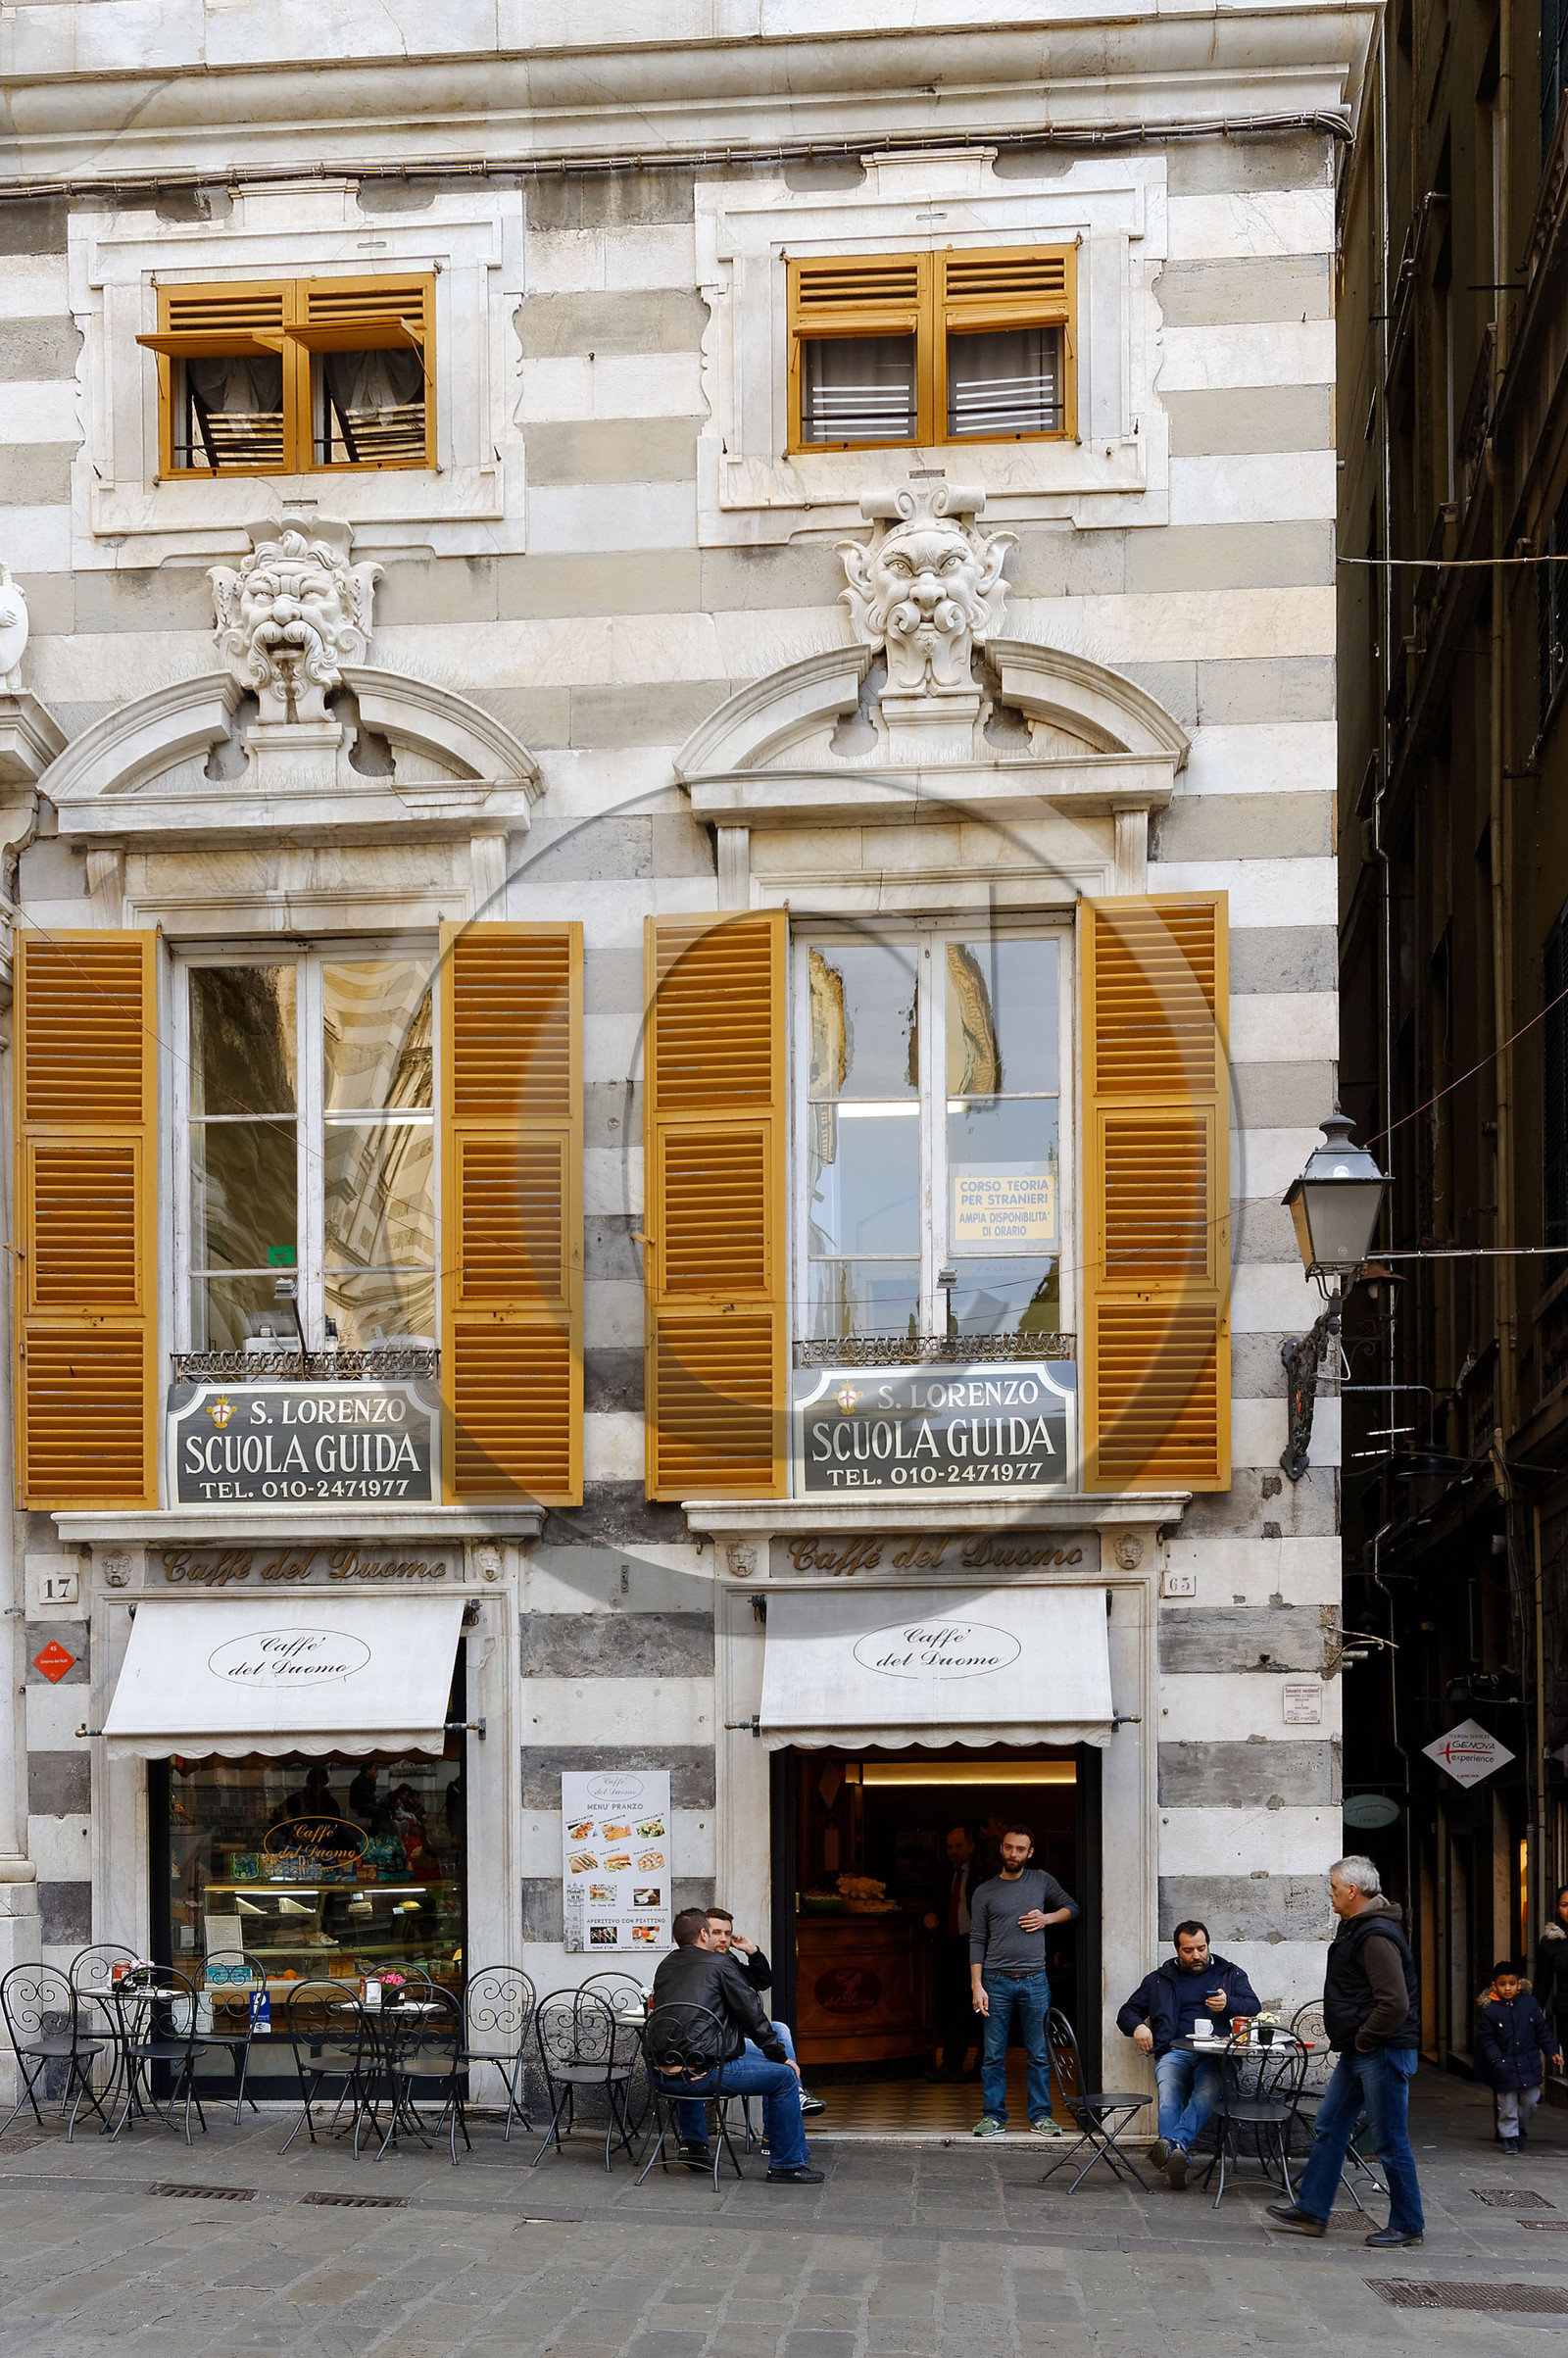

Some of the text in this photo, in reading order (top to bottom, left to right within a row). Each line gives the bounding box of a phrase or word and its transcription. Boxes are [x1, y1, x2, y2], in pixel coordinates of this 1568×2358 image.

[960, 1179, 1049, 1192] CORSO TEORIA
[961, 1193, 1049, 1205] PER STRANIERI
[959, 1213, 986, 1224] AMPIA
[982, 1226, 1027, 1236] DI ORARIO
[878, 1380, 1039, 1409] S. LORENZO
[250, 1398, 407, 1425] S. LORENZO
[812, 1415, 1057, 1462] SCUOLA GUIDA
[184, 1432, 423, 1474] SCUOLA GUIDA
[827, 1462, 1044, 1487] TEL. 010-2471977
[199, 1479, 411, 1499] TEL. 010-2471977
[892, 1536, 950, 1569] del
[961, 1535, 1084, 1568] Duomo
[261, 1548, 319, 1581] del
[327, 1548, 448, 1580] Duomo
[44, 1578, 71, 1598] 17
[228, 1659, 349, 1676] del Duomo
[876, 1650, 1003, 1668] del Duomo
[1451, 1740, 1495, 1749] GENOVA
[1451, 1754, 1494, 1763] experience
[277, 1843, 356, 1859] del Duomo
